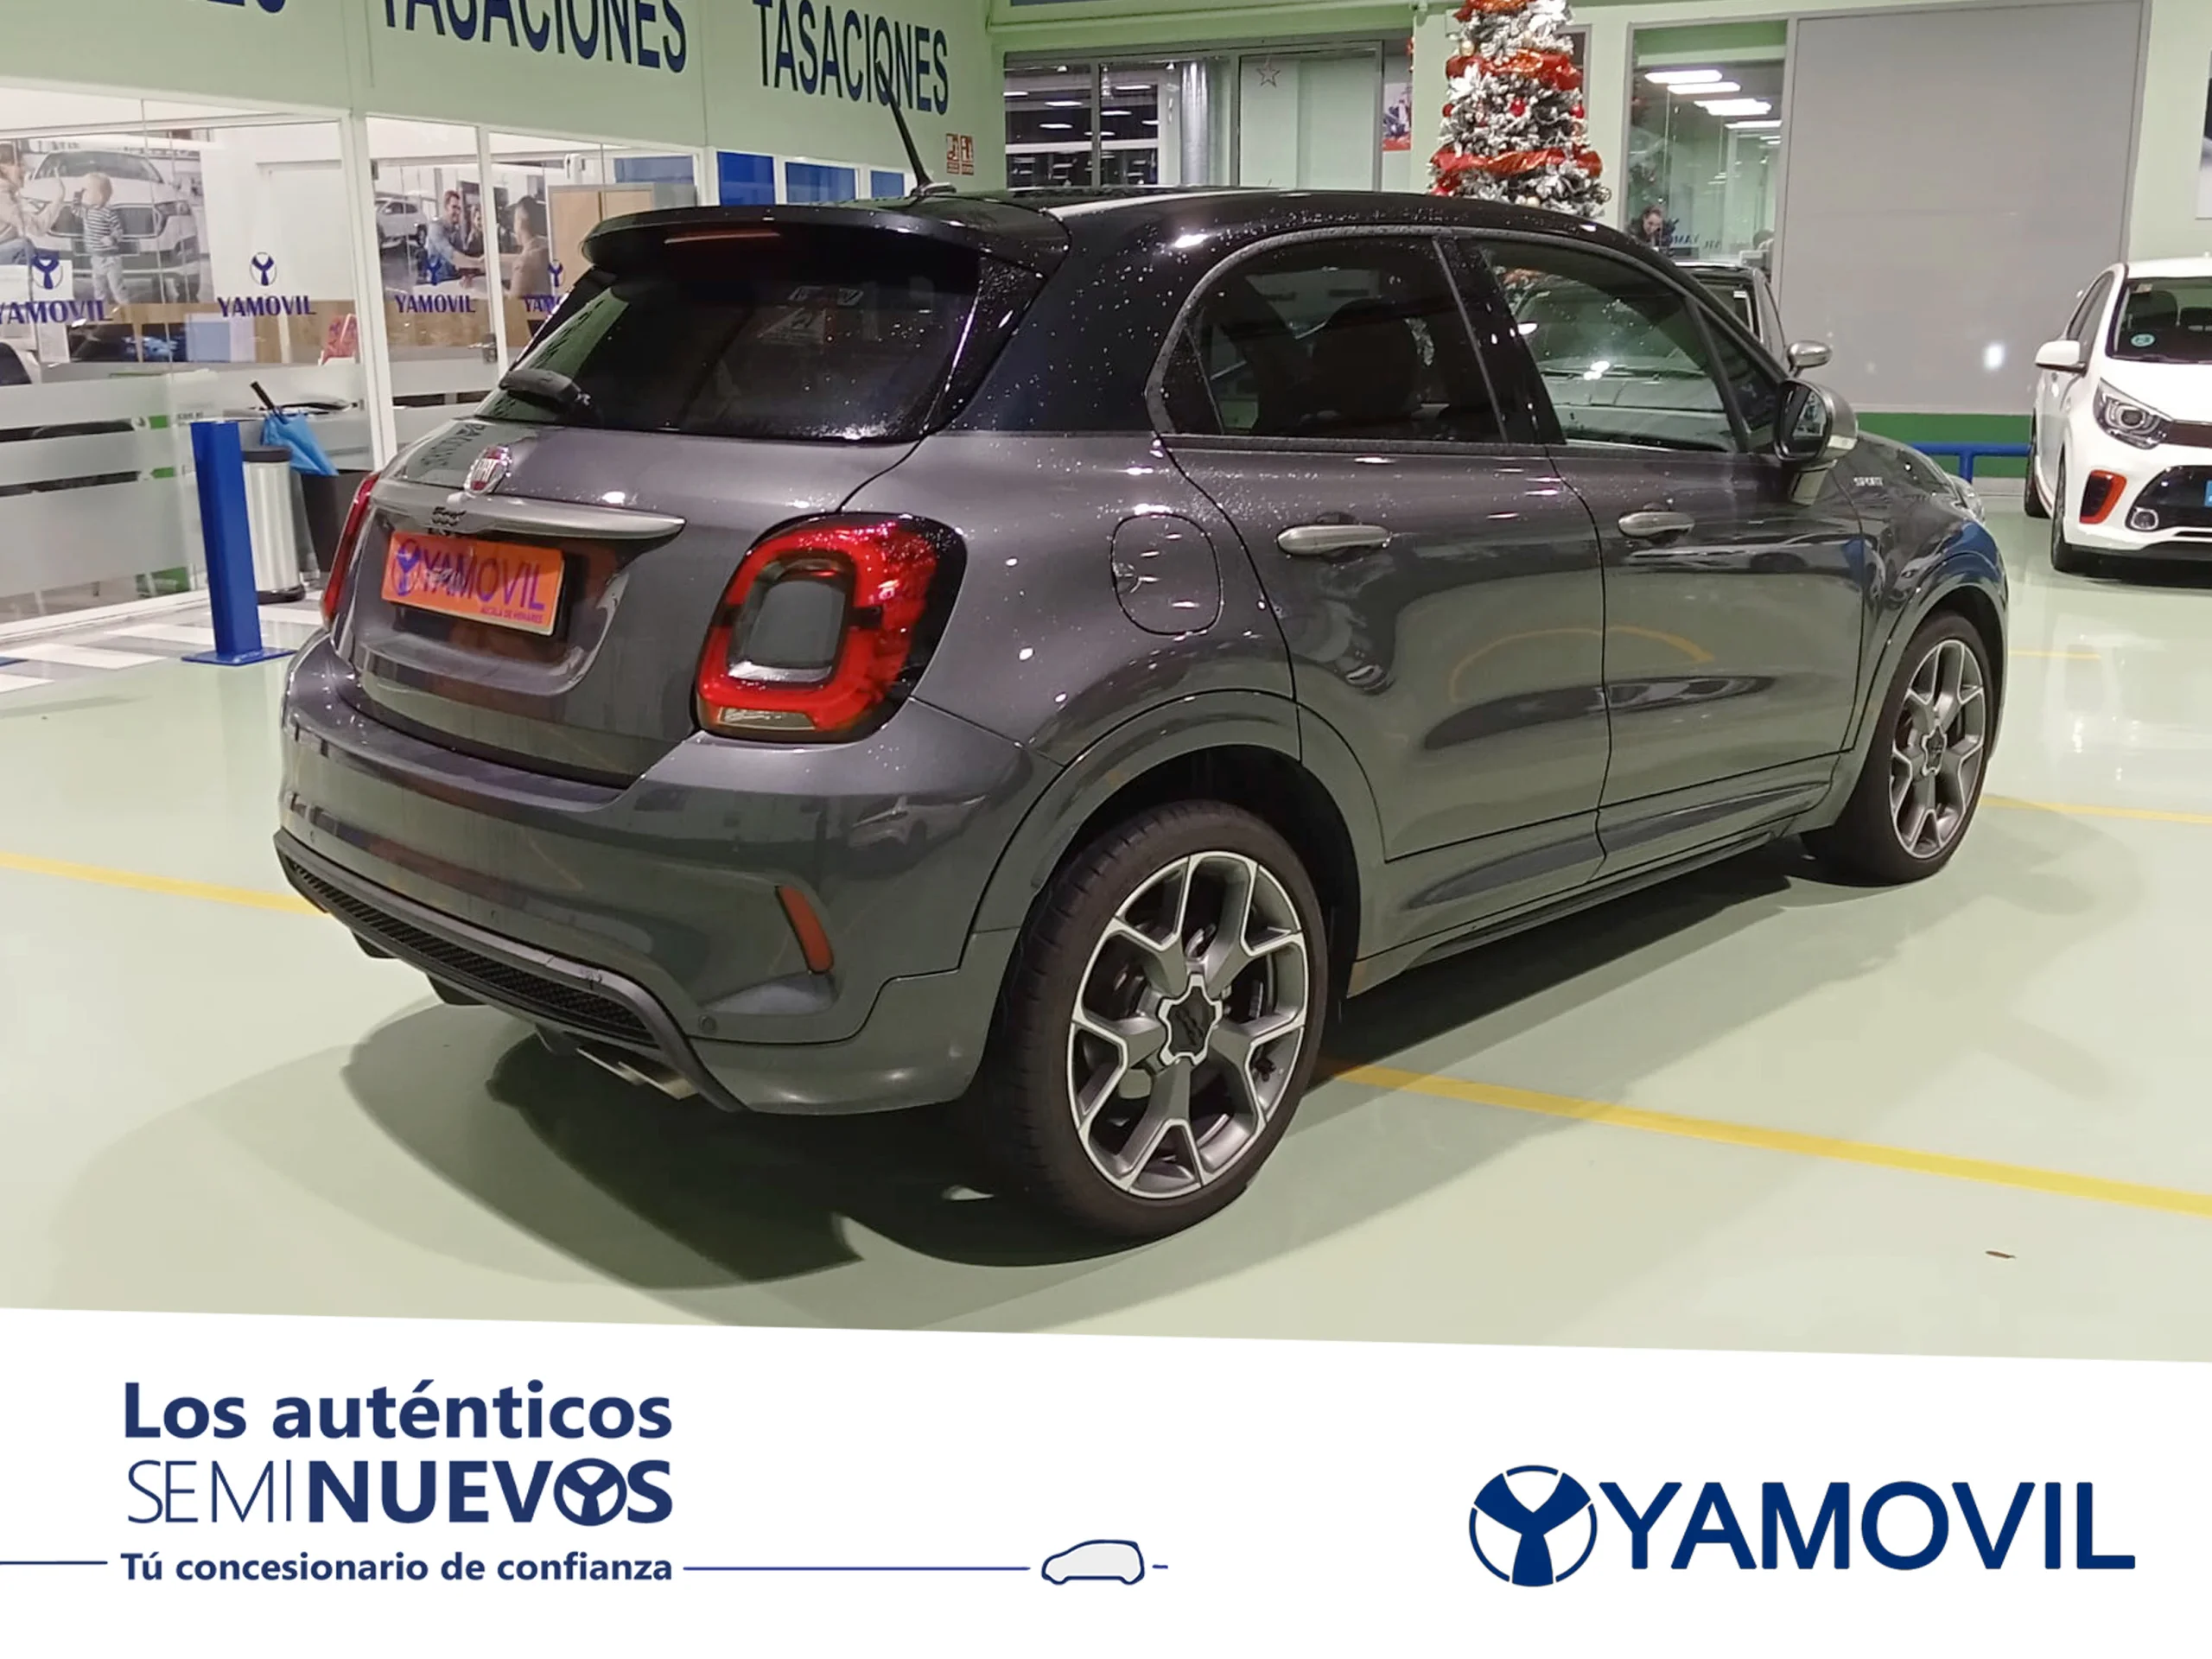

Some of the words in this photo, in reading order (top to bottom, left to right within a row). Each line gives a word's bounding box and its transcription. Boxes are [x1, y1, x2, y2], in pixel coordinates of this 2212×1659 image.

[753, 0, 949, 115] TASACIONES
[218, 296, 316, 317] YAMOVIL
[395, 295, 475, 313] YAMOVIL
[423, 549, 545, 610] YAMOVIL
